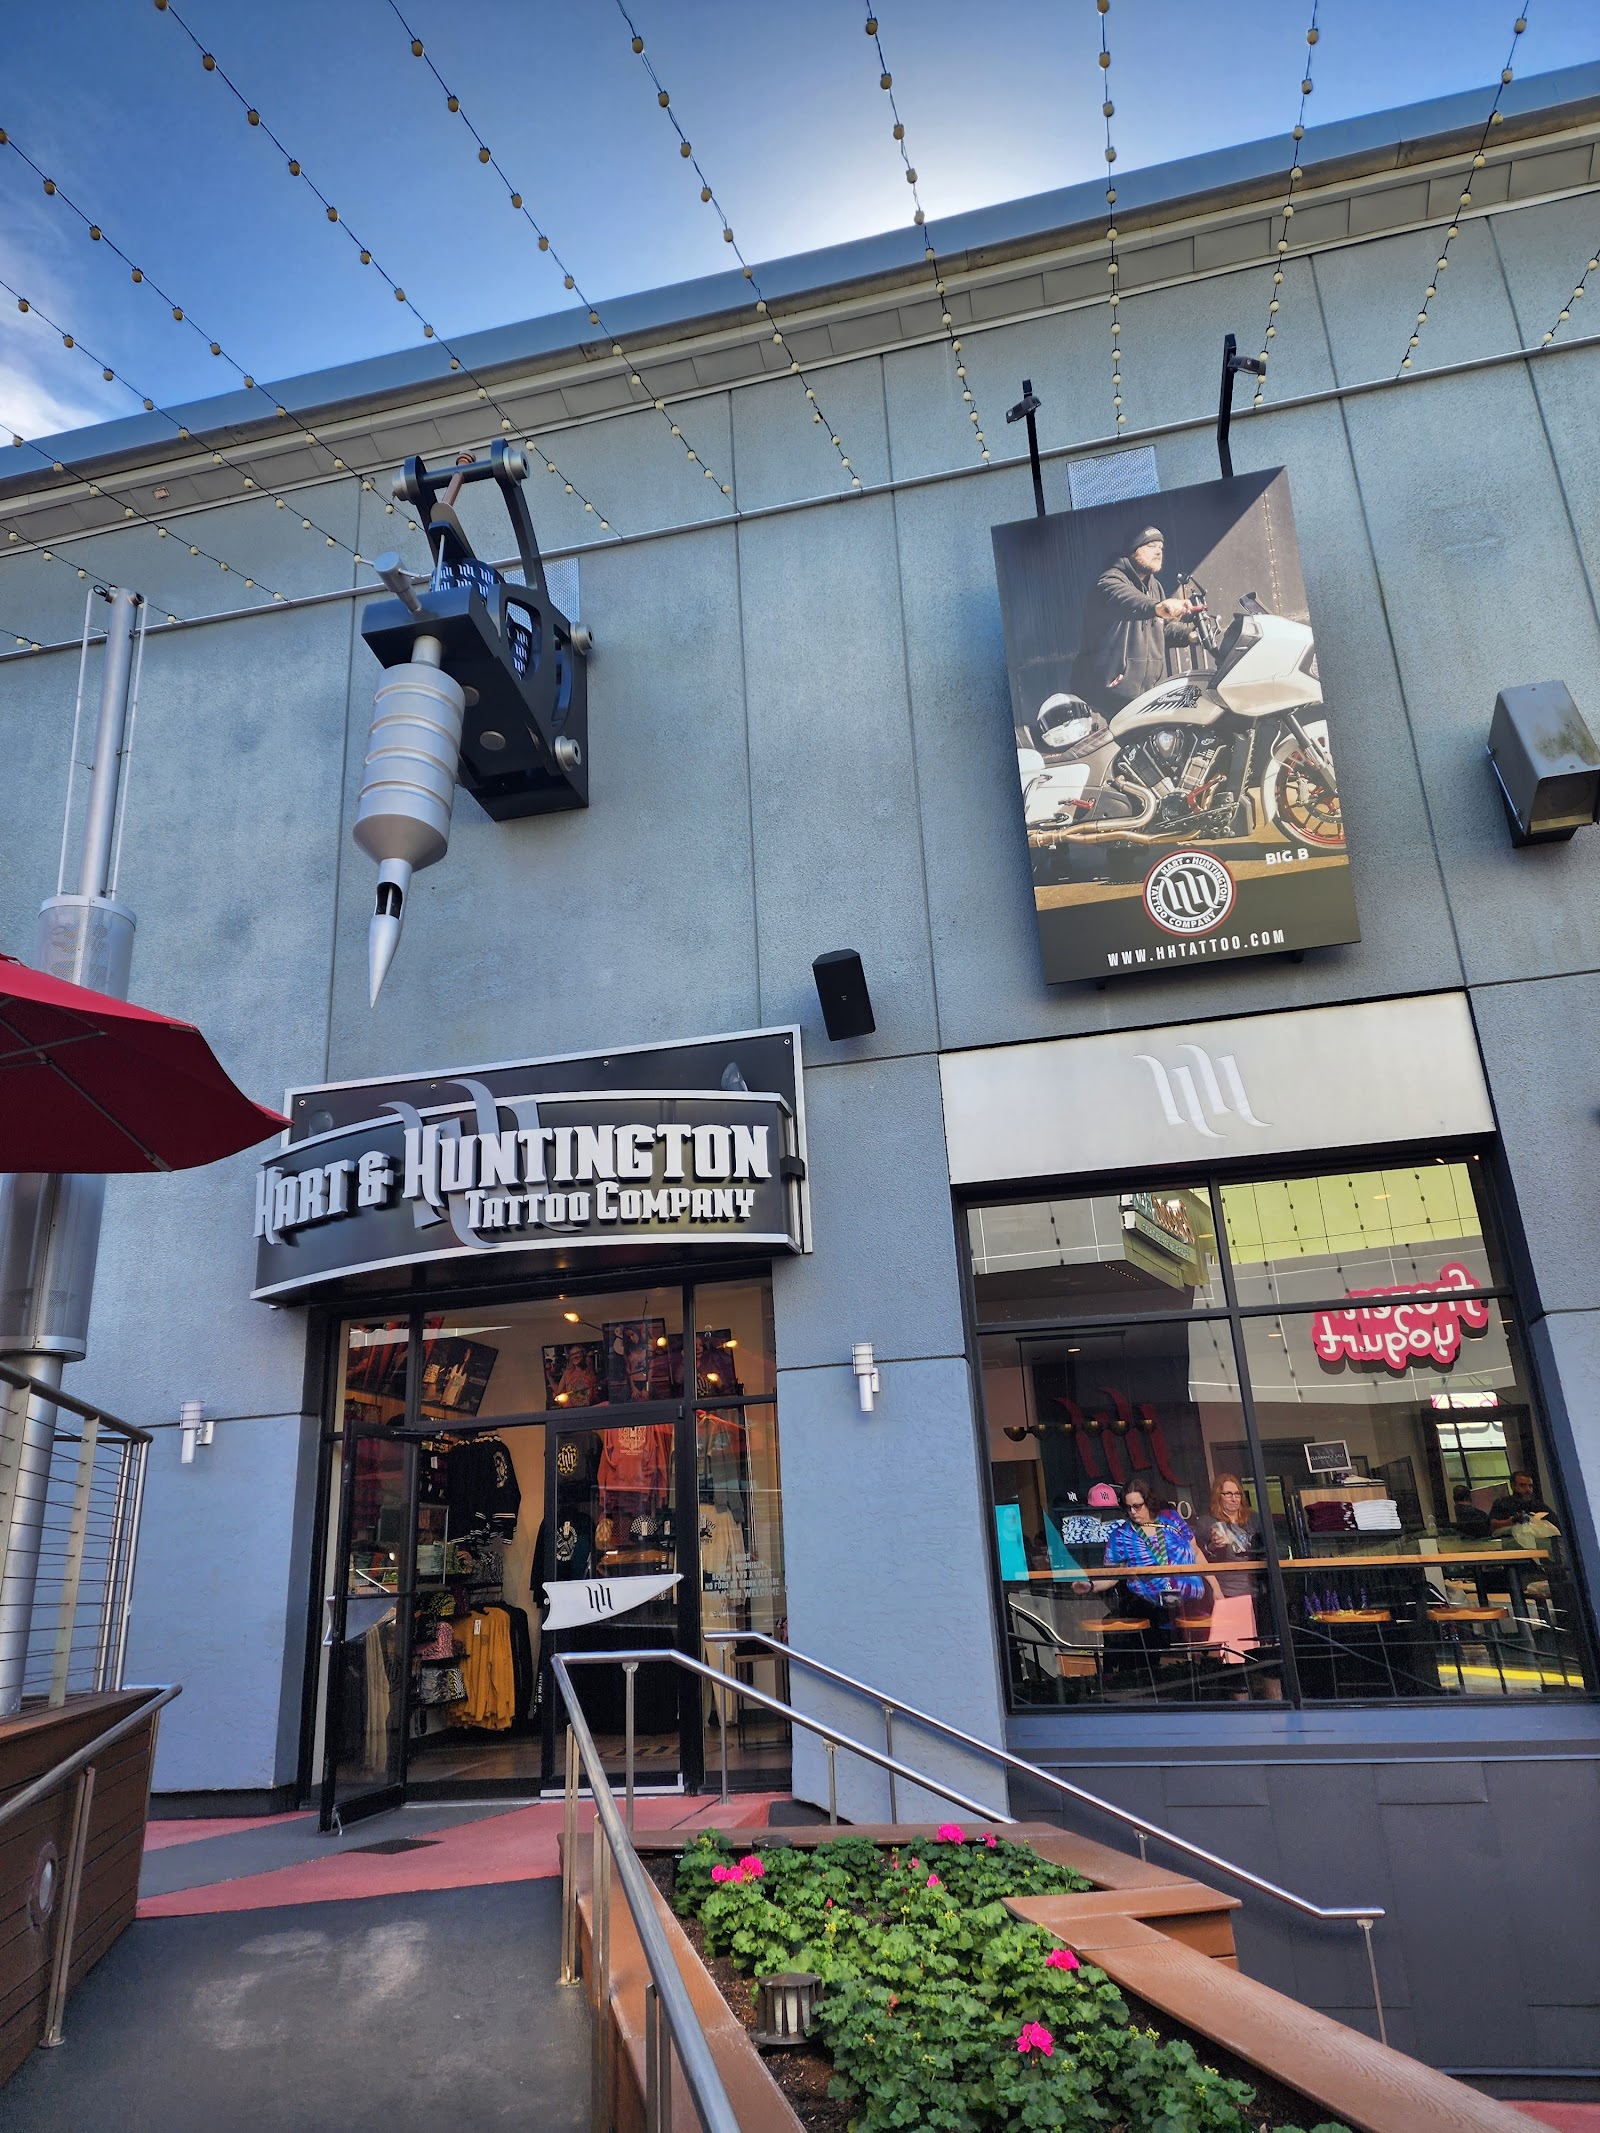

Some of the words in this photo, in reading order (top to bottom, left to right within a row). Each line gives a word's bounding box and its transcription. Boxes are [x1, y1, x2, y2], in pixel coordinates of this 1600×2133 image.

[1265, 850, 1293, 865] BIG
[1297, 848, 1310, 861] B
[1160, 857, 1184, 875] HART
[1192, 857, 1228, 902] HUNTINGTON
[1151, 885, 1168, 919] TATTOO
[1168, 911, 1216, 928] COMPANY
[1107, 929, 1285, 967] WWW.HHTATTOO.COM
[253, 1163, 355, 1246] HART
[358, 1150, 394, 1207] &
[402, 1123, 773, 1208] HUNTINGTON
[464, 1189, 591, 1230] TATTOO
[595, 1181, 756, 1222] COMPANY
